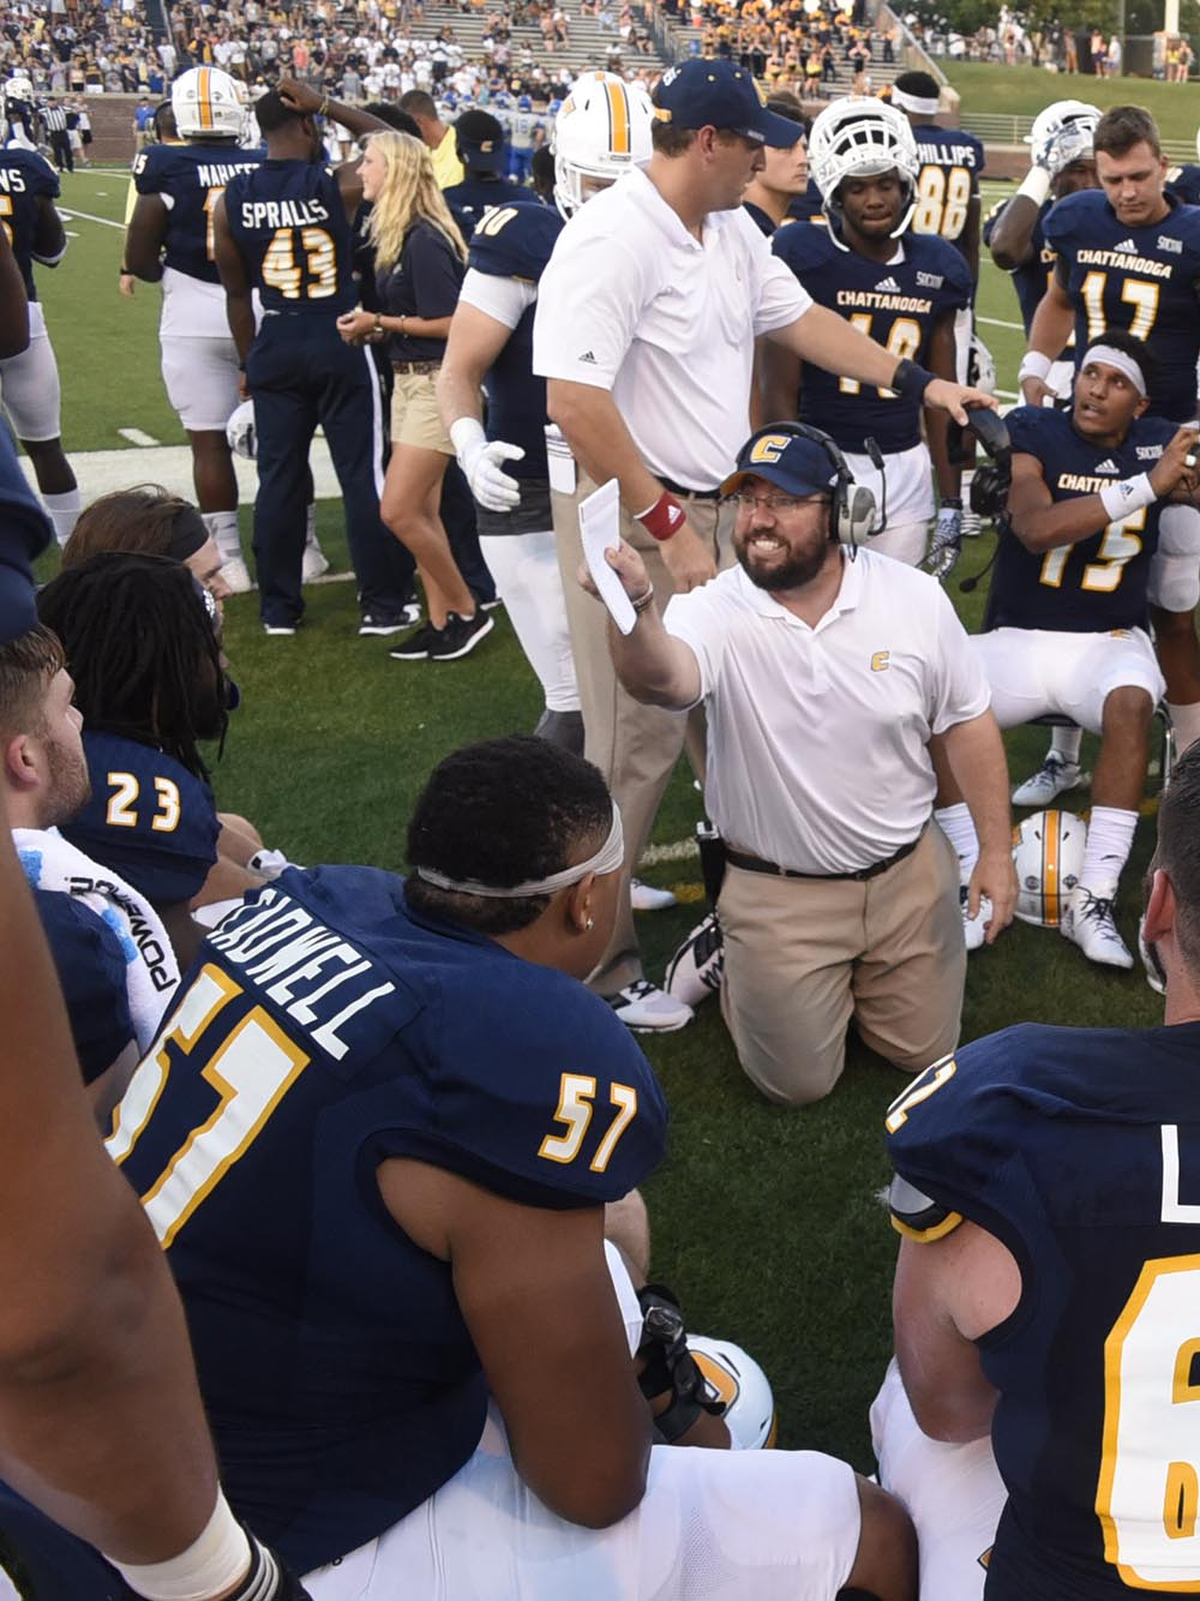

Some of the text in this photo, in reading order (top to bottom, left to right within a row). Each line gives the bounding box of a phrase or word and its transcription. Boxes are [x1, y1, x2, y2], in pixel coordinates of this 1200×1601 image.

[917, 143, 976, 167] HILLIPS
[242, 199, 329, 229] SPRALLS
[912, 166, 971, 240] 88
[261, 227, 337, 299] 43
[1076, 250, 1173, 280] CHATTANOOGA
[836, 291, 953, 315] CHATTANOOGA
[1080, 270, 1160, 344] 17
[750, 434, 793, 465] C
[1056, 473, 1127, 495] CHATTA
[870, 651, 891, 672] C
[105, 771, 182, 833] 23
[536, 1072, 640, 1173] 57
